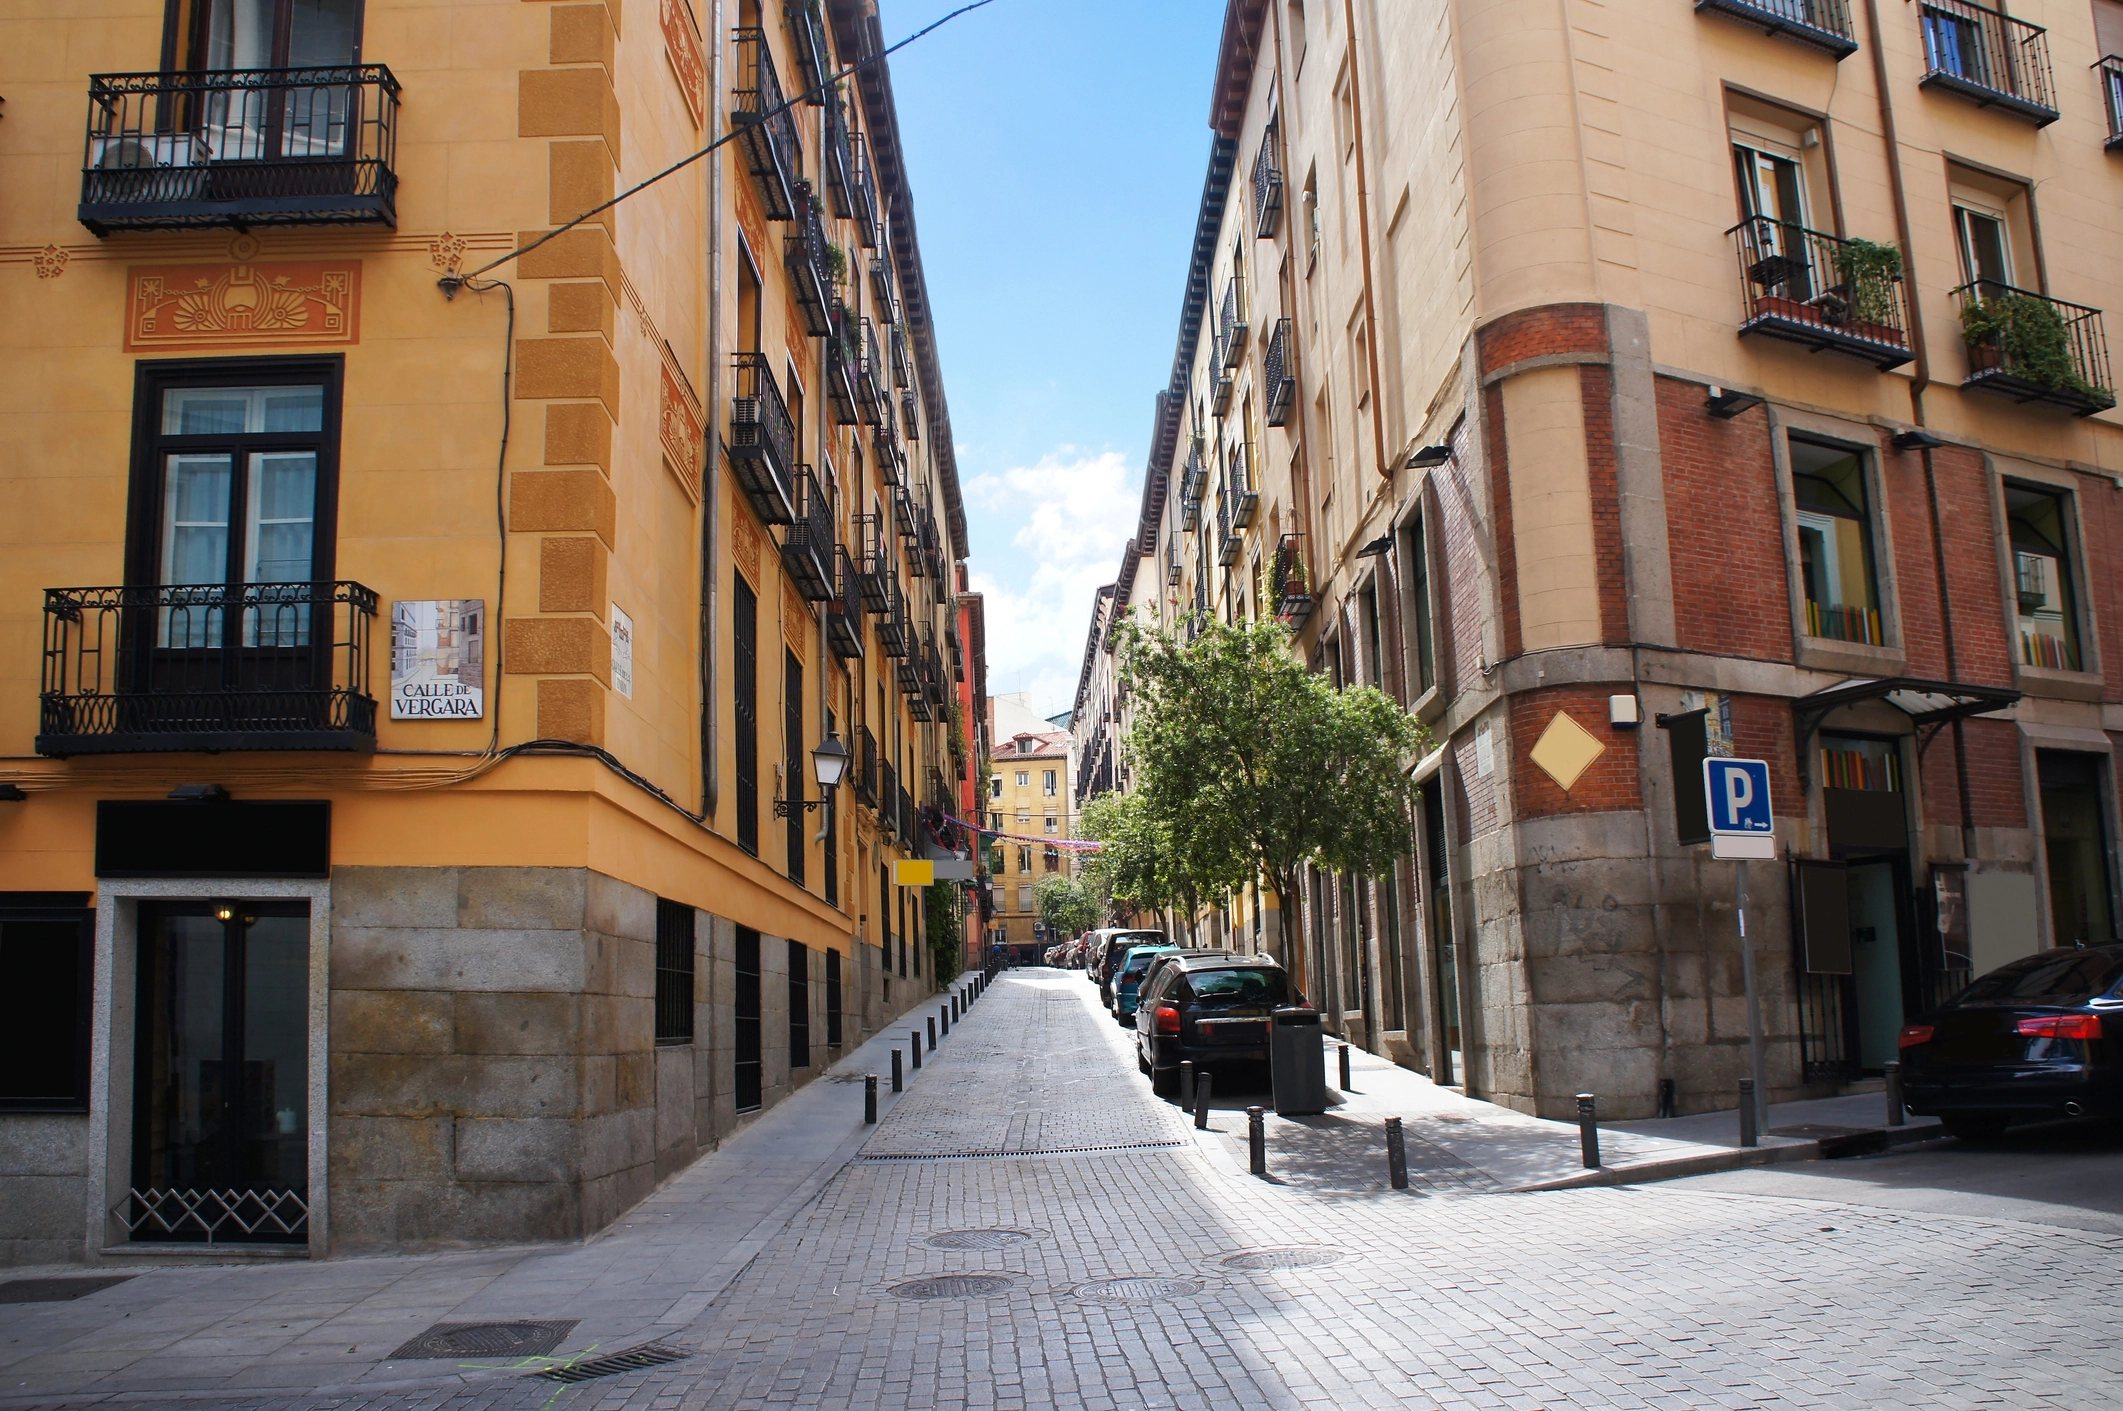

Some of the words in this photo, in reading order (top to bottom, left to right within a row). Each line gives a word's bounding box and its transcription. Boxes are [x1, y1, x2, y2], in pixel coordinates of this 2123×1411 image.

[403, 684, 454, 698] CALLE
[456, 685, 471, 695] DE
[394, 698, 479, 716] VERGARA
[1724, 766, 1753, 825] P
